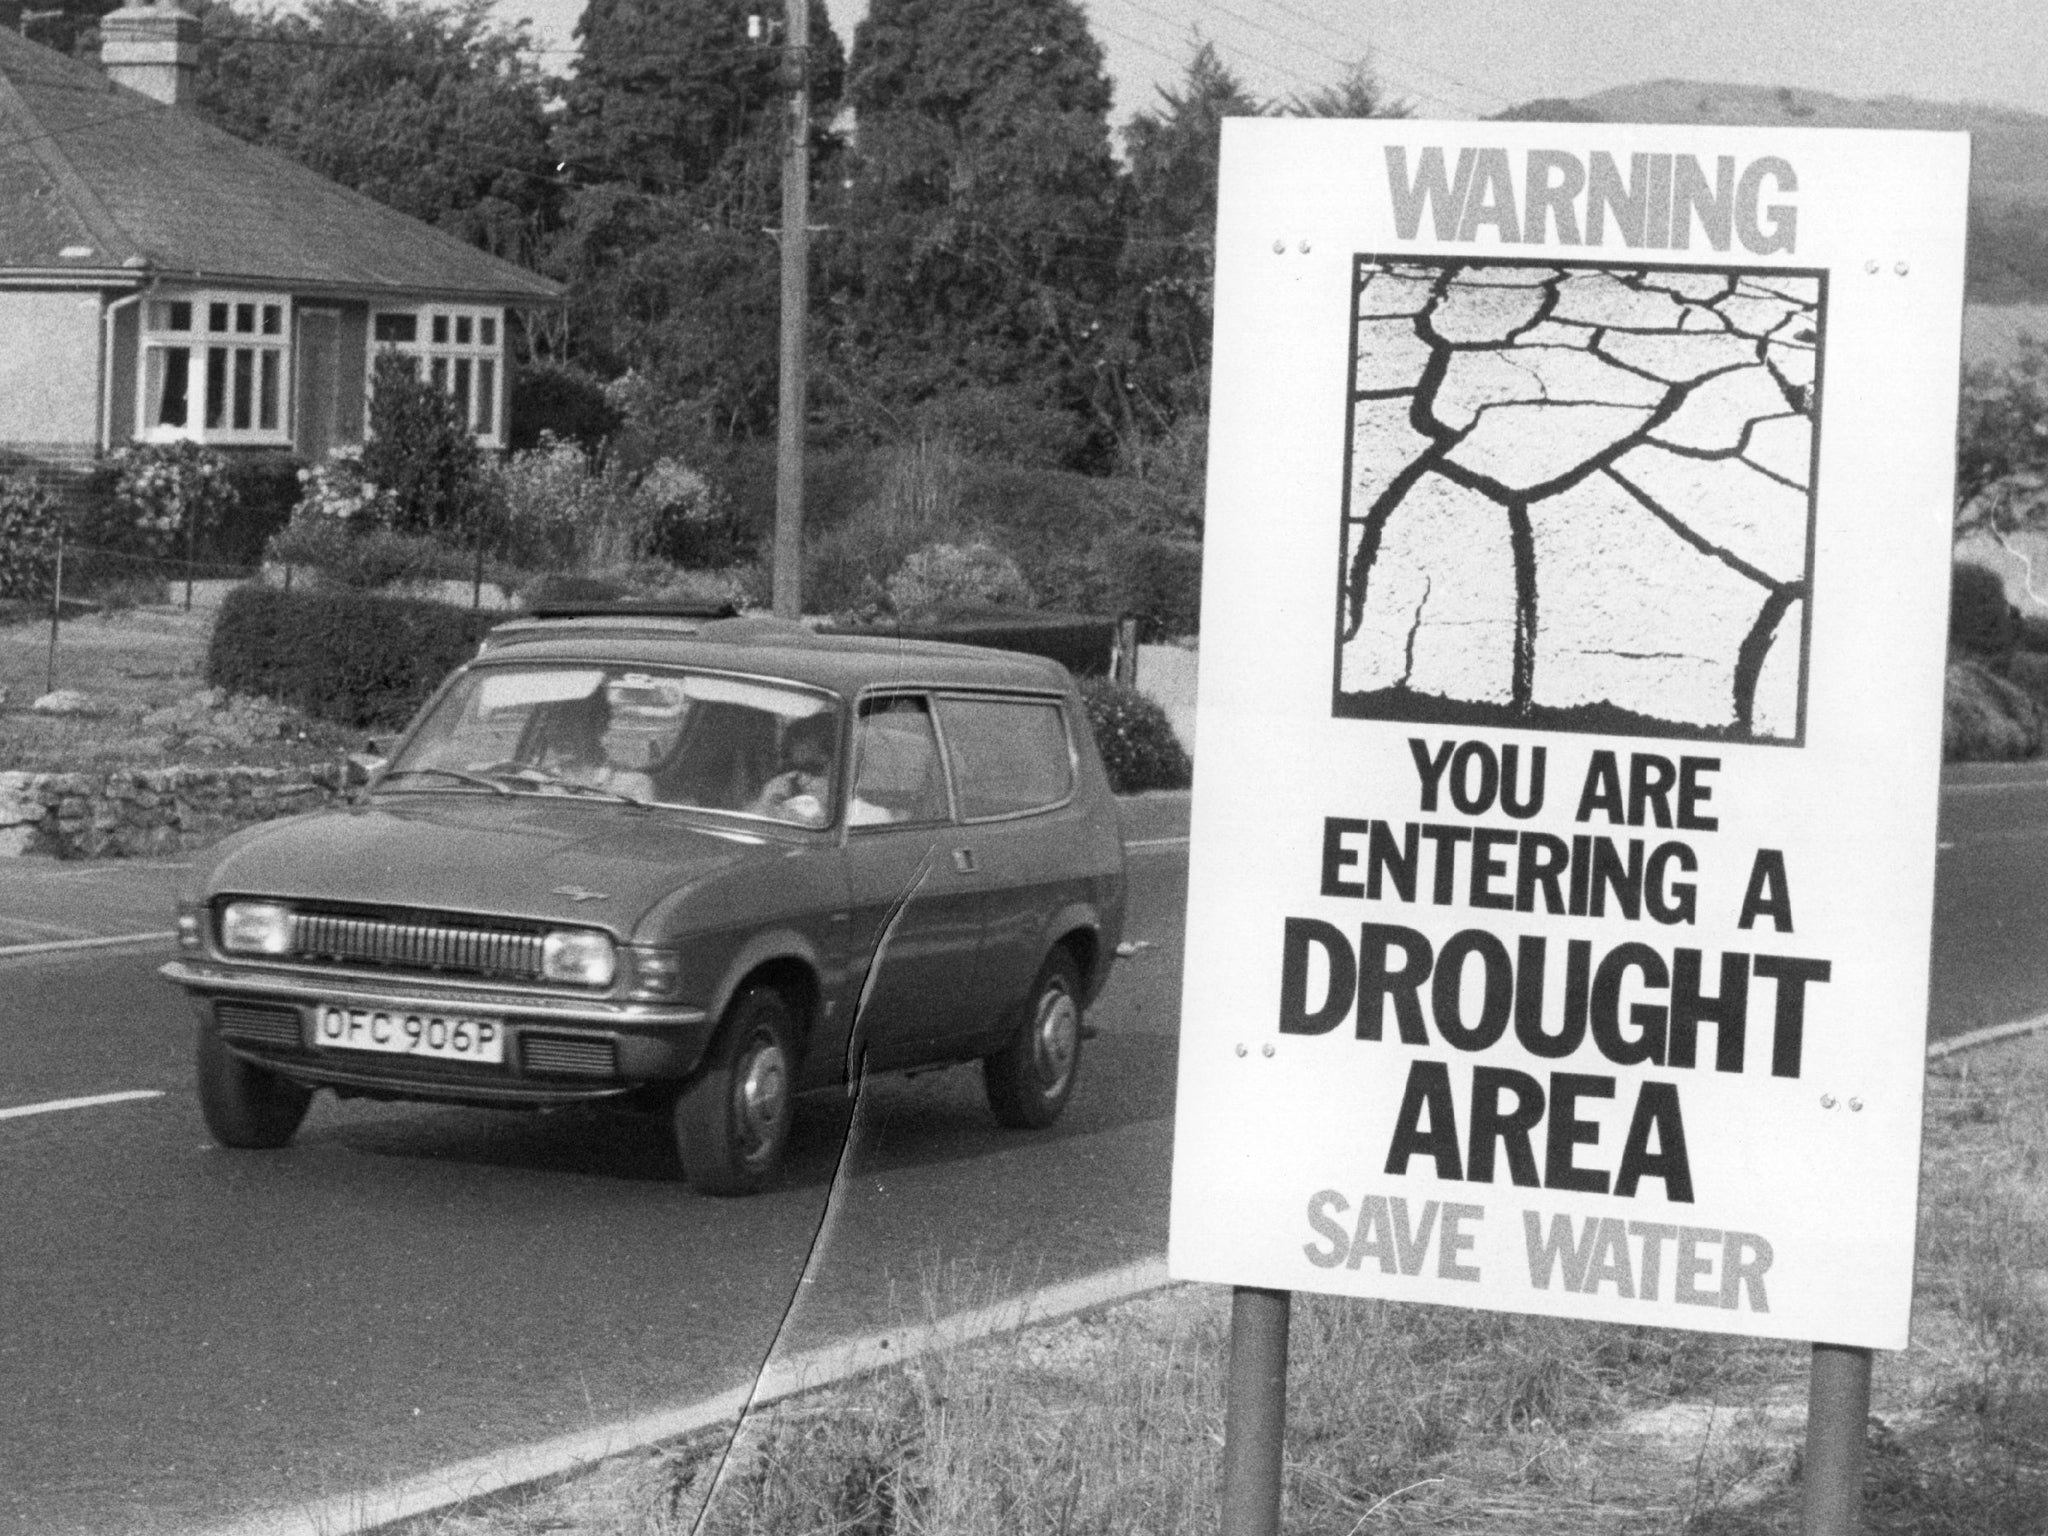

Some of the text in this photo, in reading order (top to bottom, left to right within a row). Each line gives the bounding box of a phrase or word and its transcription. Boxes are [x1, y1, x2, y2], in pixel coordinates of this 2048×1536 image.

[1385, 146, 1797, 255] WARNING
[1408, 738, 1721, 832] YOU ARE
[1320, 816, 1795, 934] ENTERING A
[323, 1008, 494, 1054] OFC 906P
[1279, 916, 1832, 1080] DROUGHT
[1384, 1059, 1695, 1204] AREA
[1303, 1190, 1774, 1313] SAVE WATER
